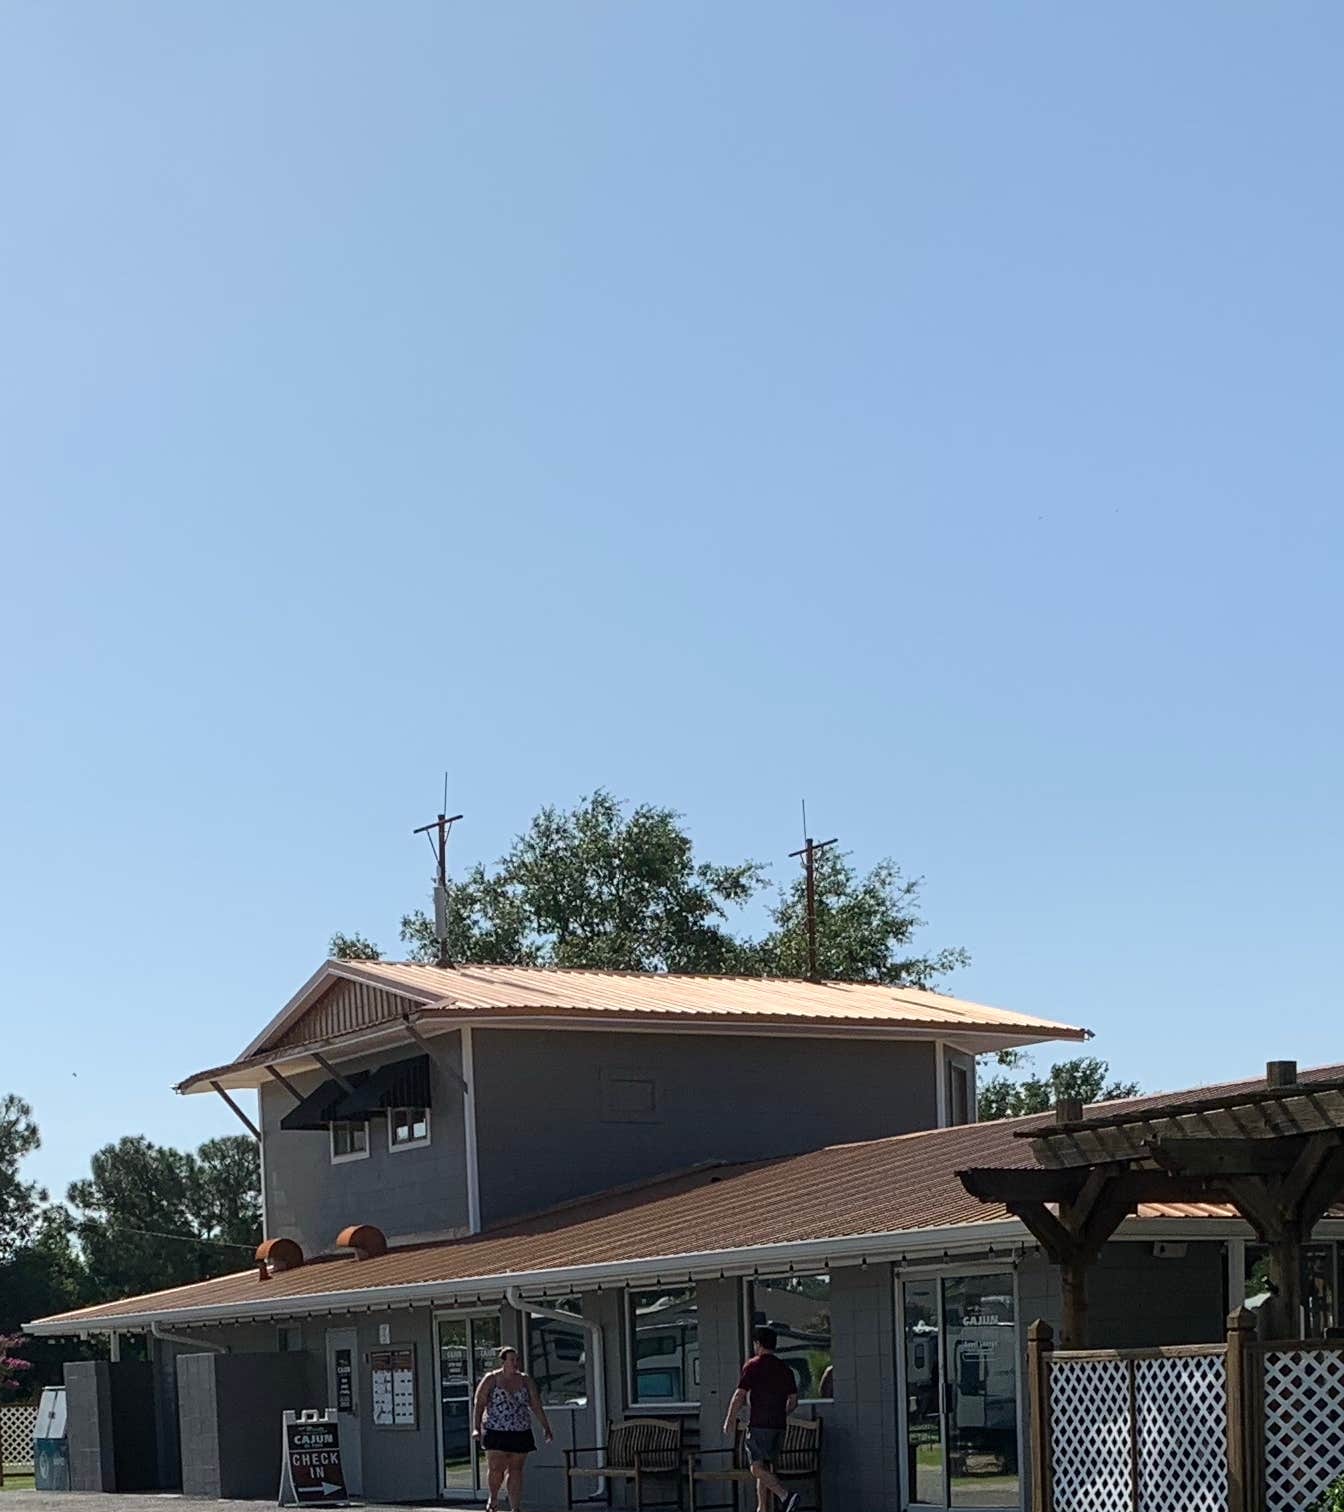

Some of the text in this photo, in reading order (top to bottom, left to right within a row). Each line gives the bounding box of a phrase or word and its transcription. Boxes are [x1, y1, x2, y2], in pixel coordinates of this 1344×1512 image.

[294, 1434, 333, 1445] CAJUN
[292, 1452, 338, 1466] CHECK
[309, 1466, 325, 1479] IN
